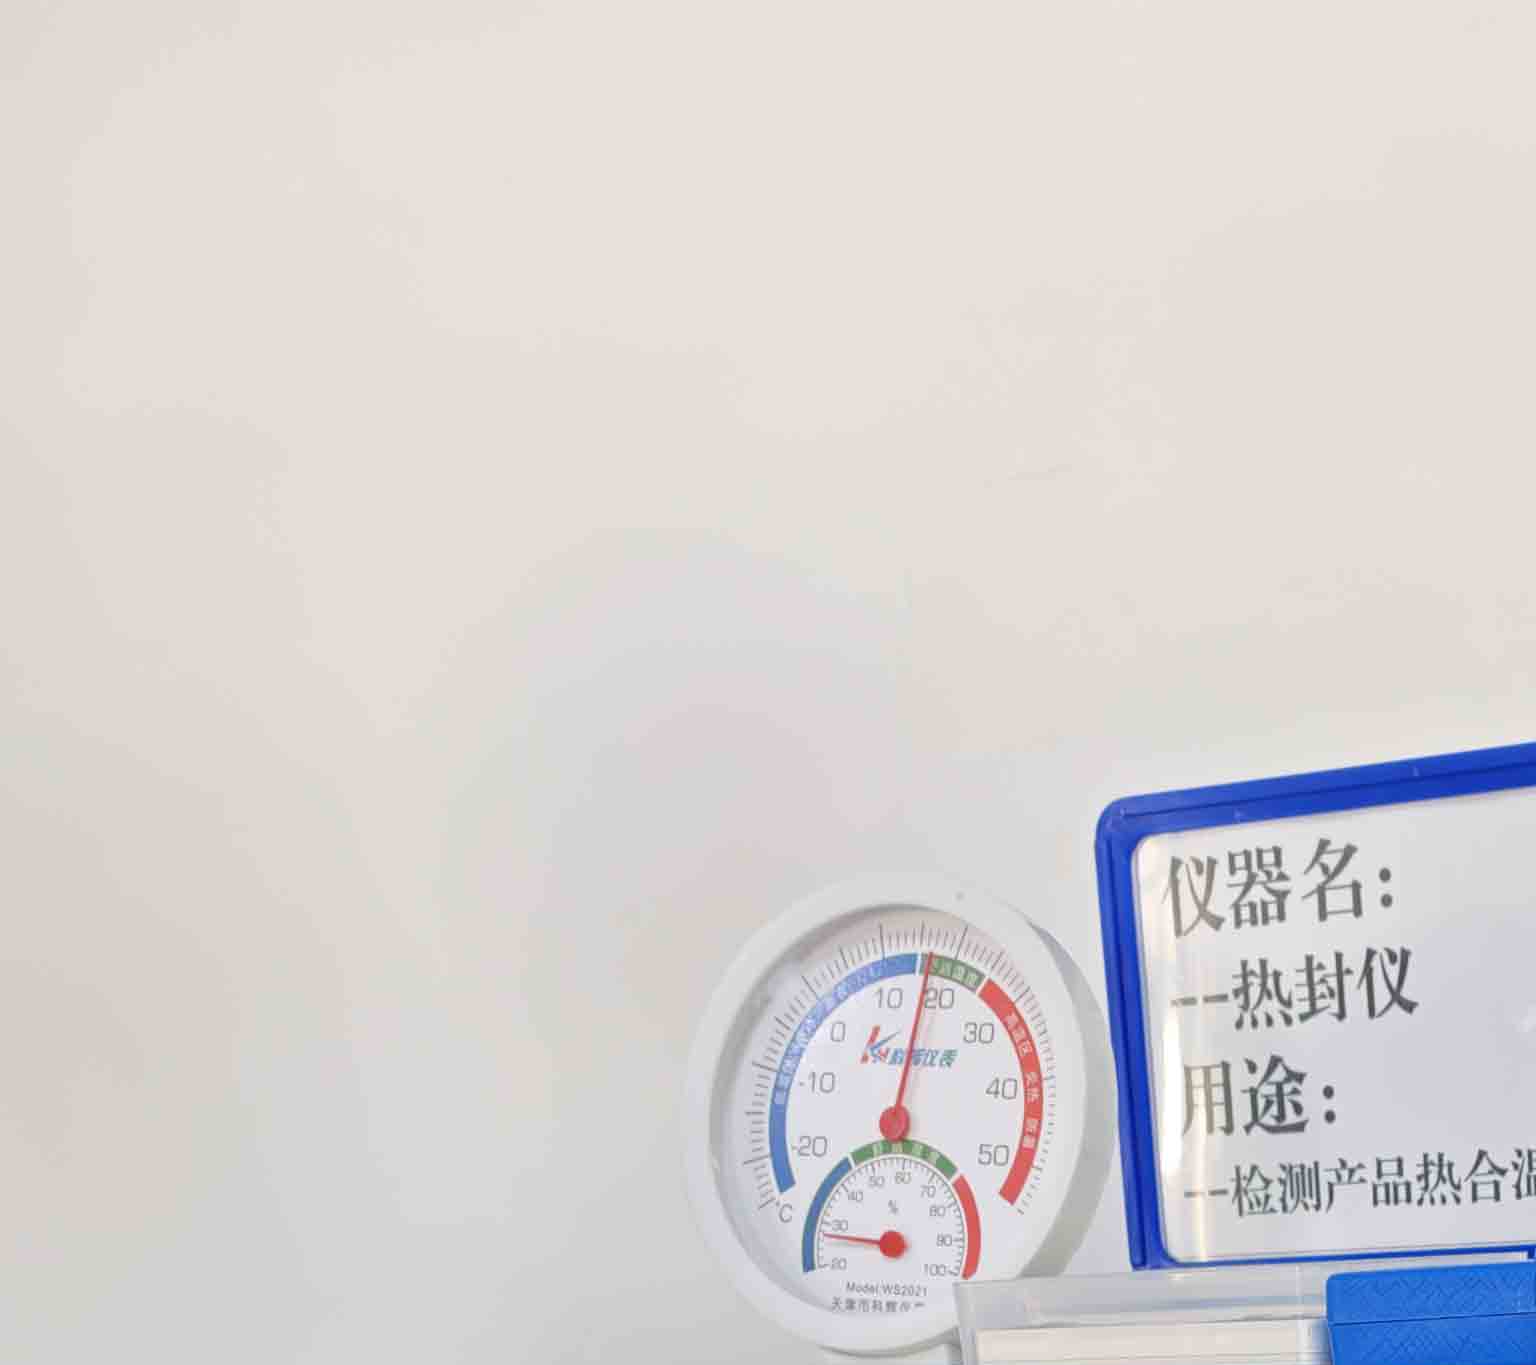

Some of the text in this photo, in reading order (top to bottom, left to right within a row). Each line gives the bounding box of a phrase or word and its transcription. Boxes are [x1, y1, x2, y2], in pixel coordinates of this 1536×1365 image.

[1164, 837, 1394, 937] 仪器名：
[876, 988, 904, 1010] 10
[922, 988, 955, 1010] 20
[829, 1022, 847, 1044] 0
[962, 1022, 996, 1044] 30
[798, 1072, 837, 1095] -10
[985, 1078, 1019, 1100] 40
[1182, 1055, 1336, 1137] 用途：
[791, 1137, 828, 1158] -20
[977, 1145, 1009, 1167] 50
[868, 1175, 886, 1189] 50
[919, 1185, 937, 1199] 70
[831, 1218, 850, 1232] 30
[923, 1263, 948, 1277] 100
